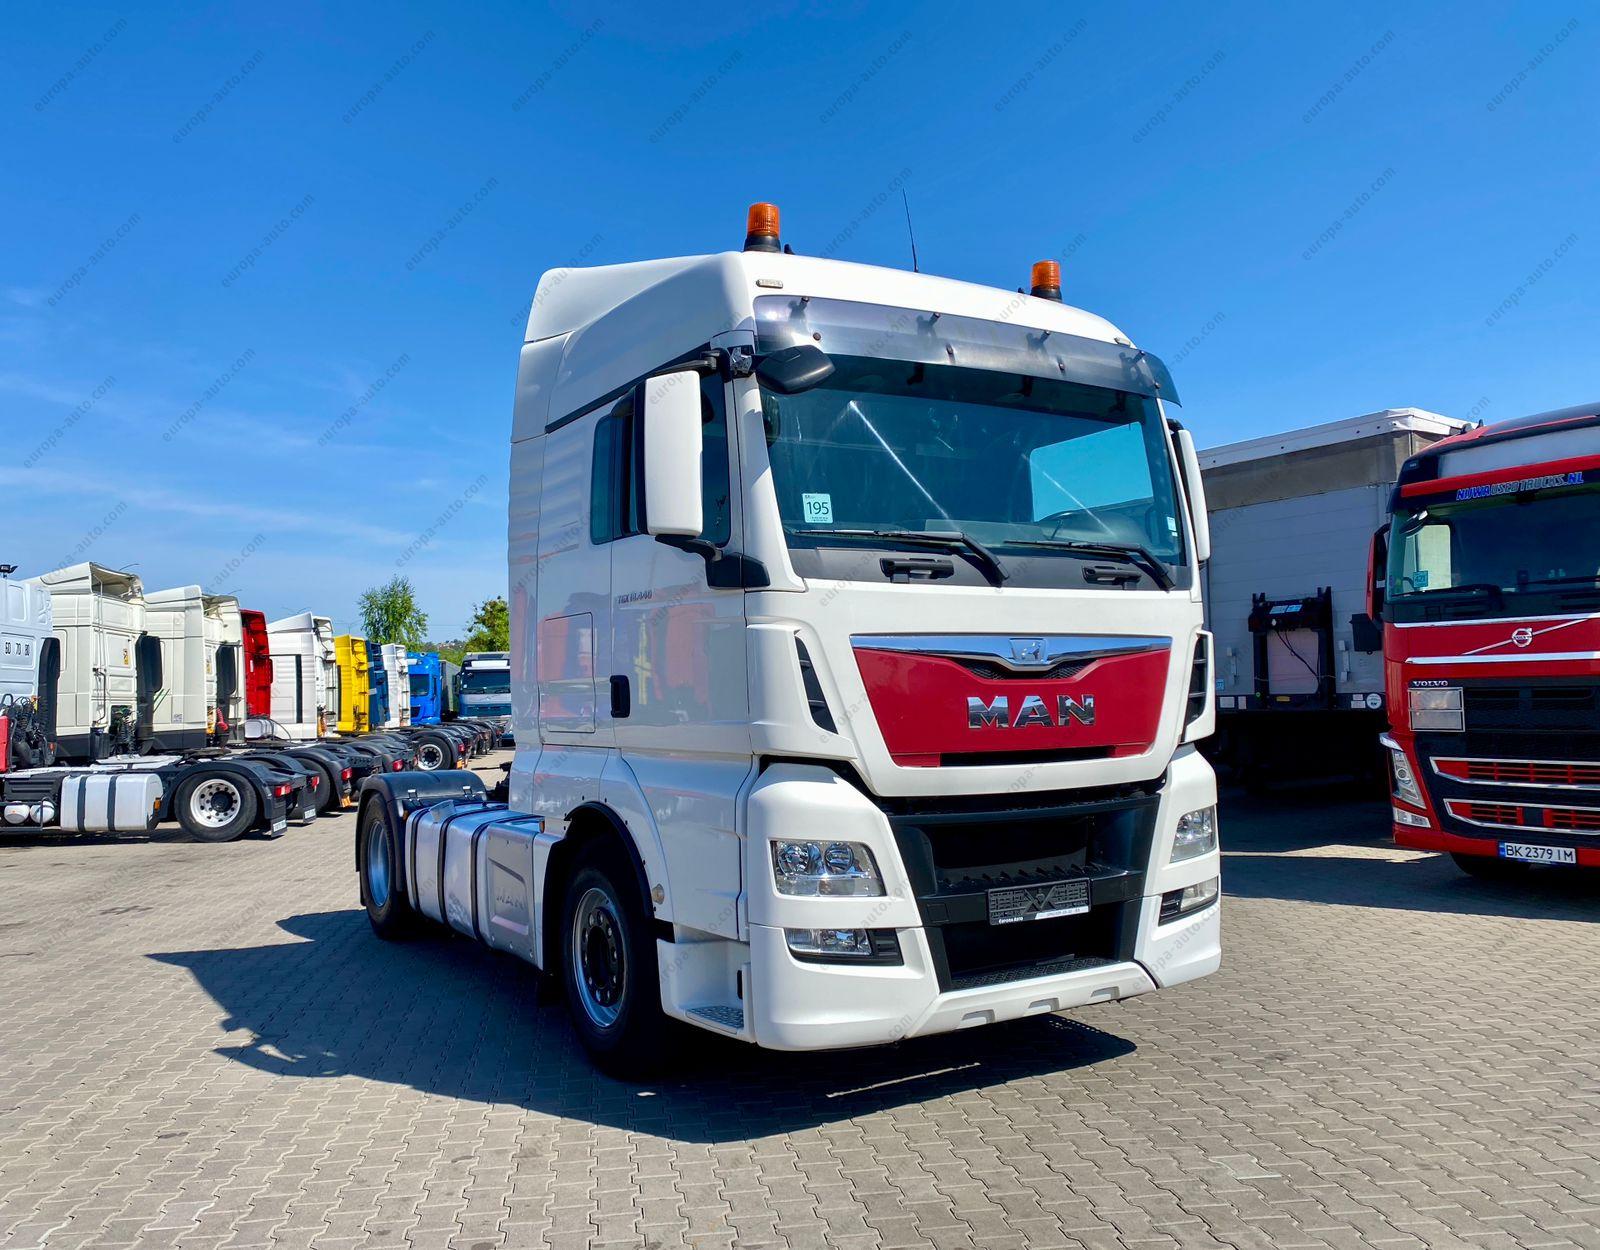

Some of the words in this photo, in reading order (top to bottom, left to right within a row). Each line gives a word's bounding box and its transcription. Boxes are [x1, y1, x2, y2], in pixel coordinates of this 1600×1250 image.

[806, 501, 829, 515] 195
[967, 694, 1097, 729] MAN
[1506, 845, 1523, 857] BK
[1525, 847, 1553, 860] 2379
[1557, 849, 1574, 862] IM
